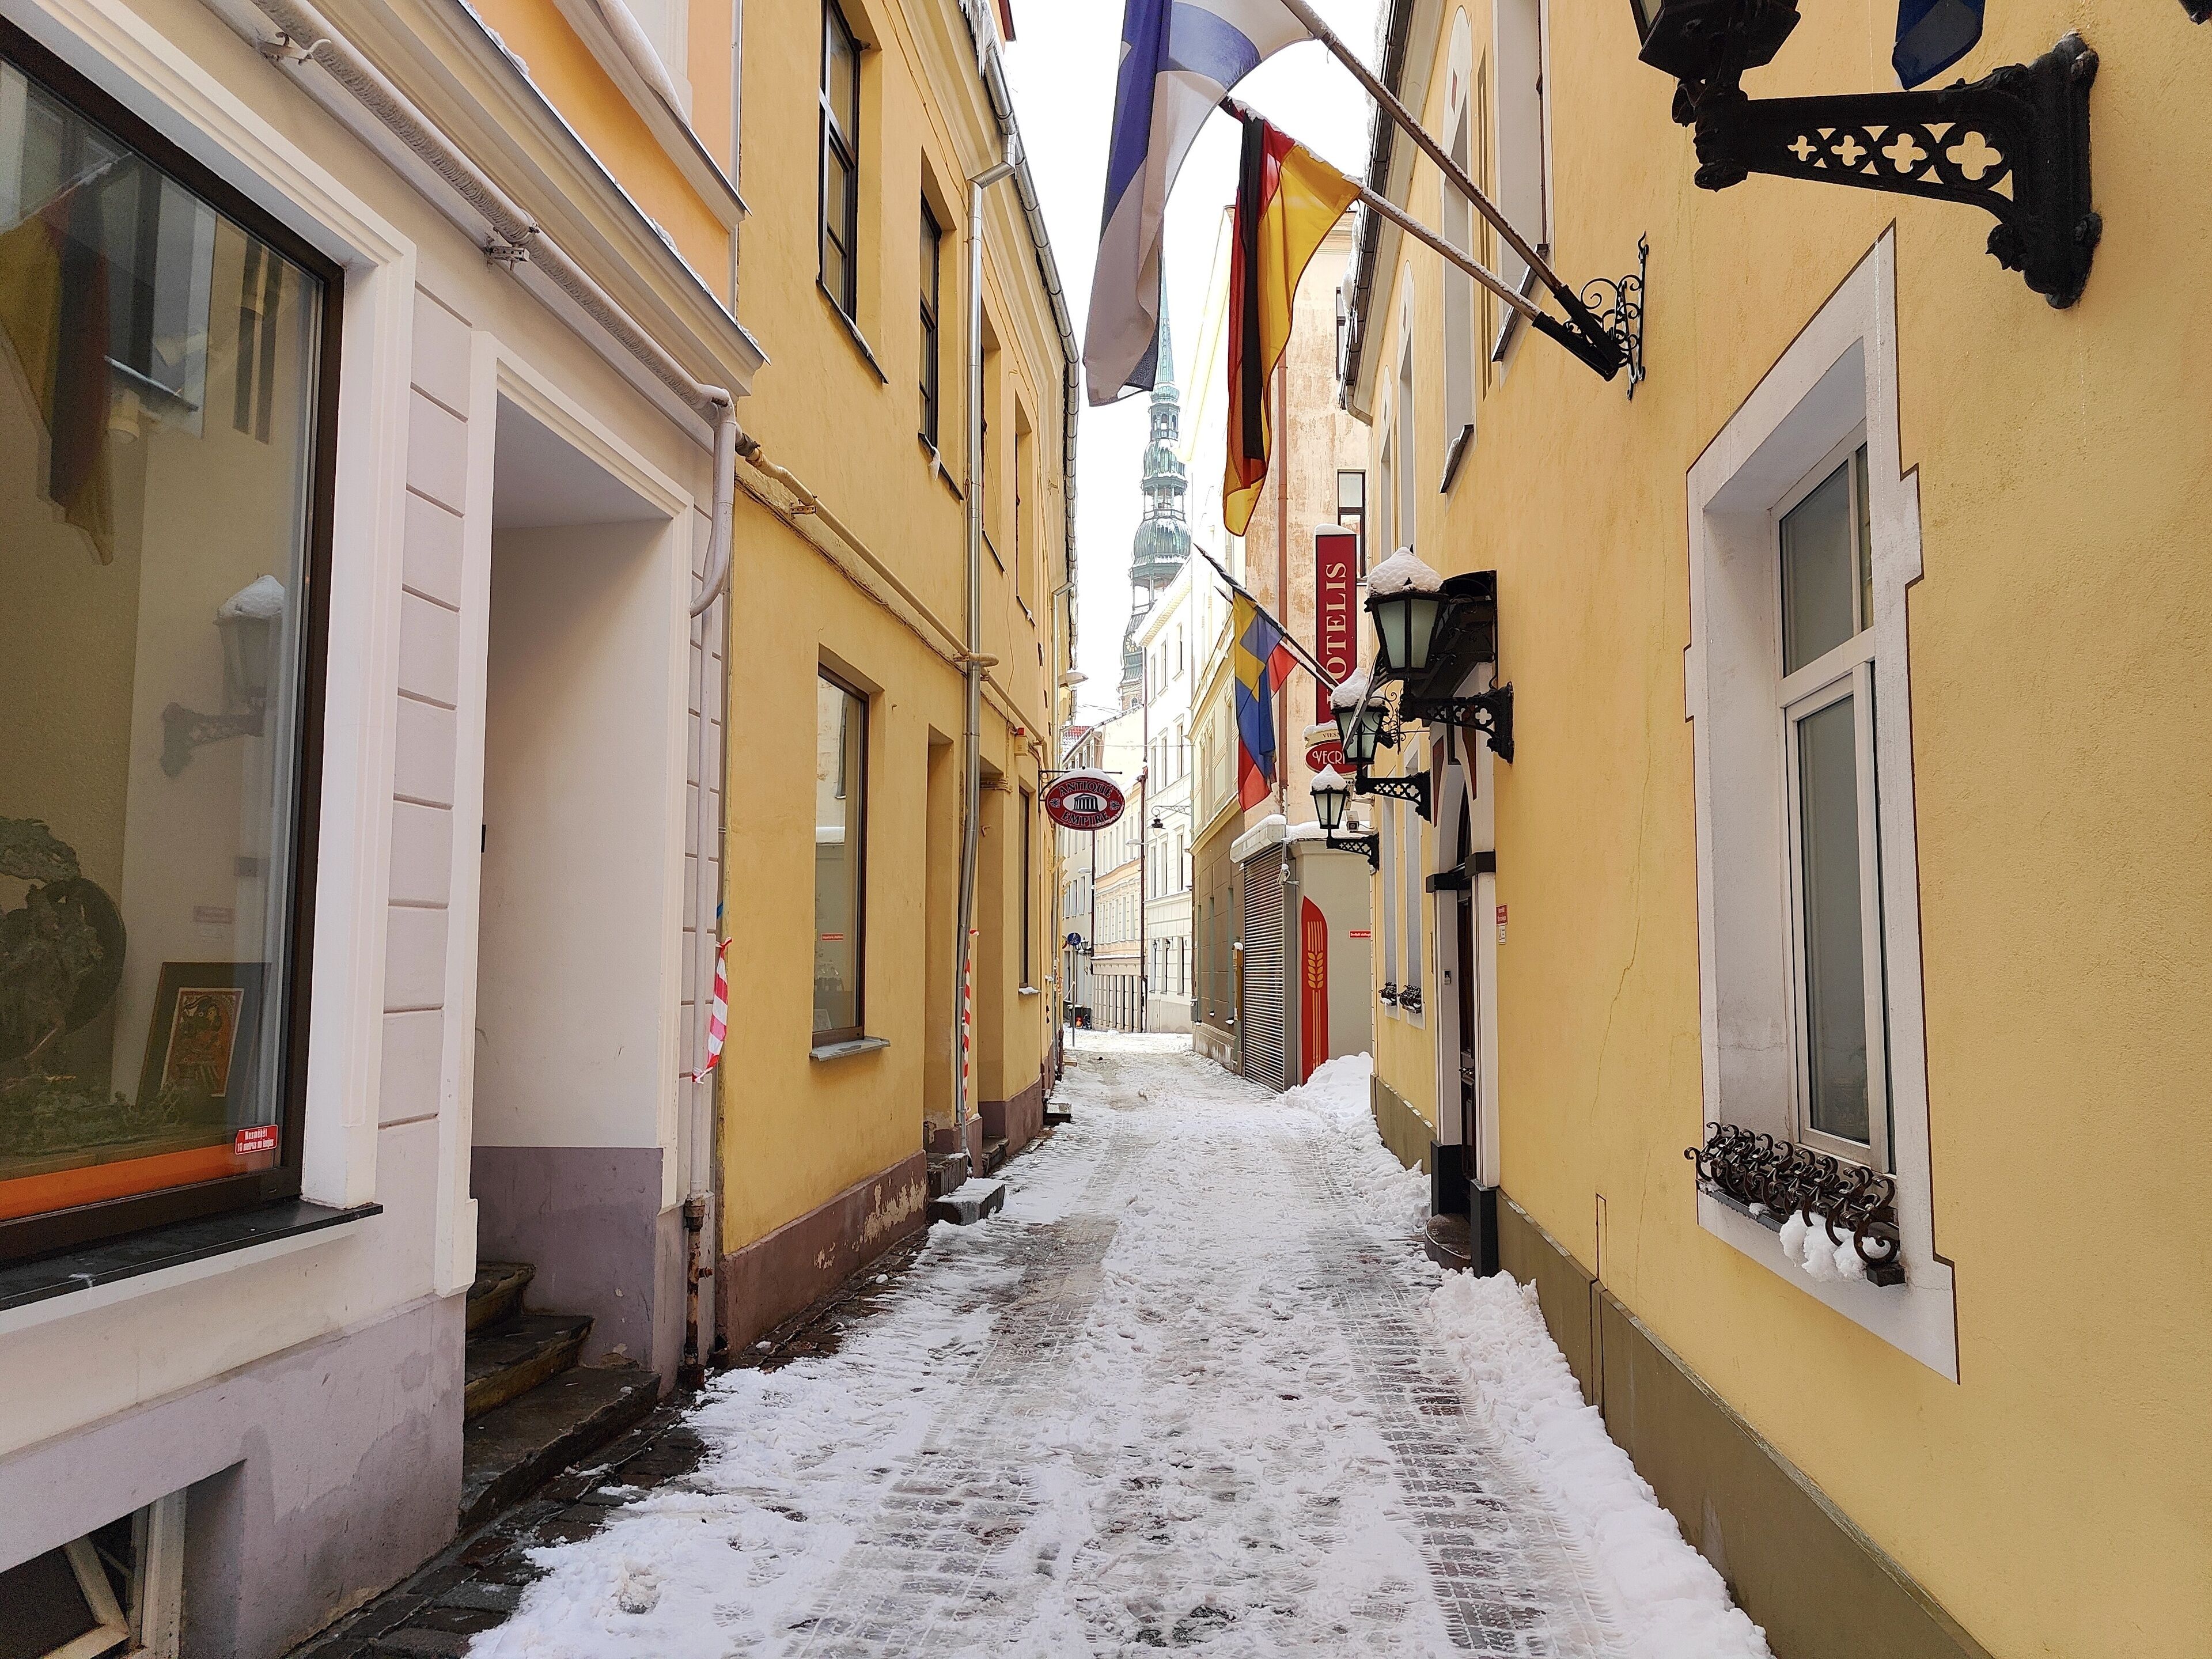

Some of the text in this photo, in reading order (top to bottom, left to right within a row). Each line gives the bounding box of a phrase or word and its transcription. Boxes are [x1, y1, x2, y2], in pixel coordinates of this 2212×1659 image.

[1059, 781, 1113, 798] ANTIQUE
[1061, 810, 1111, 827] EMPIRE
[237, 1142, 243, 1153] 10
